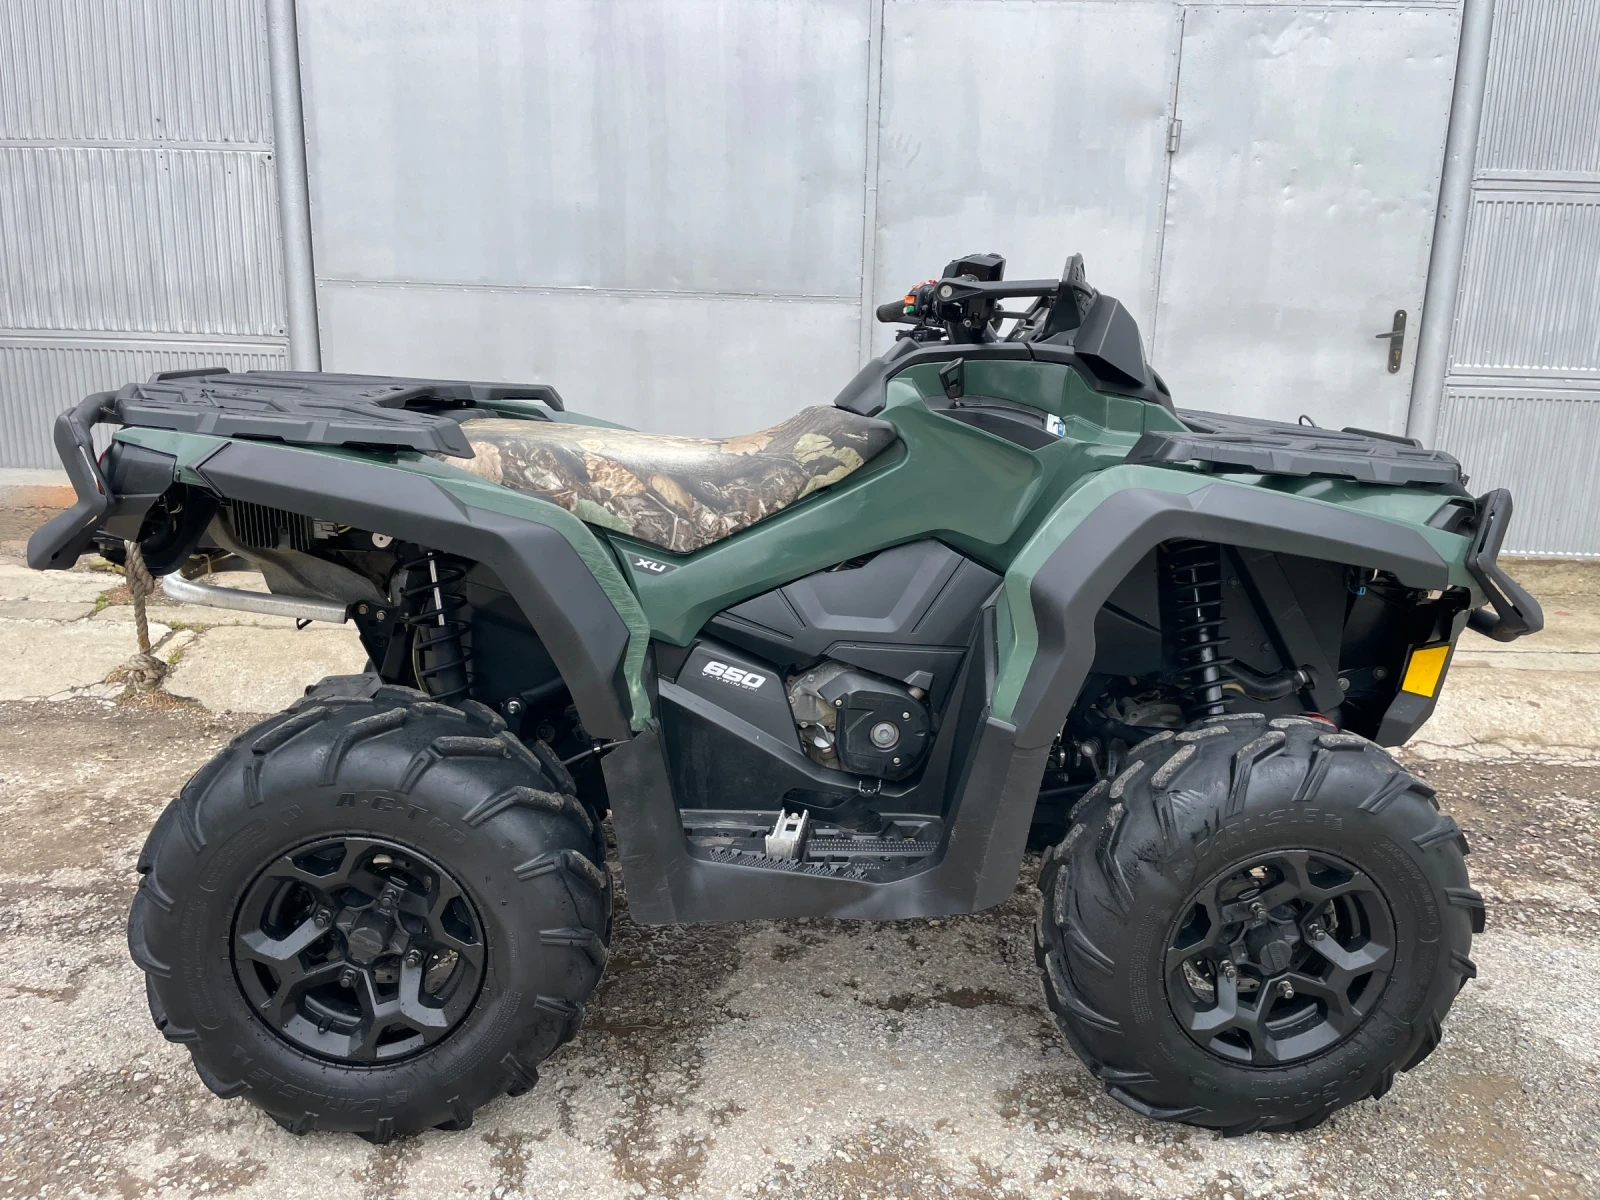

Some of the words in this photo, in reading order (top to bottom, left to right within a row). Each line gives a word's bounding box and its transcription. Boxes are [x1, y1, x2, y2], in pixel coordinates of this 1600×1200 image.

[634, 558, 667, 573] XU
[702, 661, 767, 688] 650
[702, 671, 741, 687] V-TWIN
